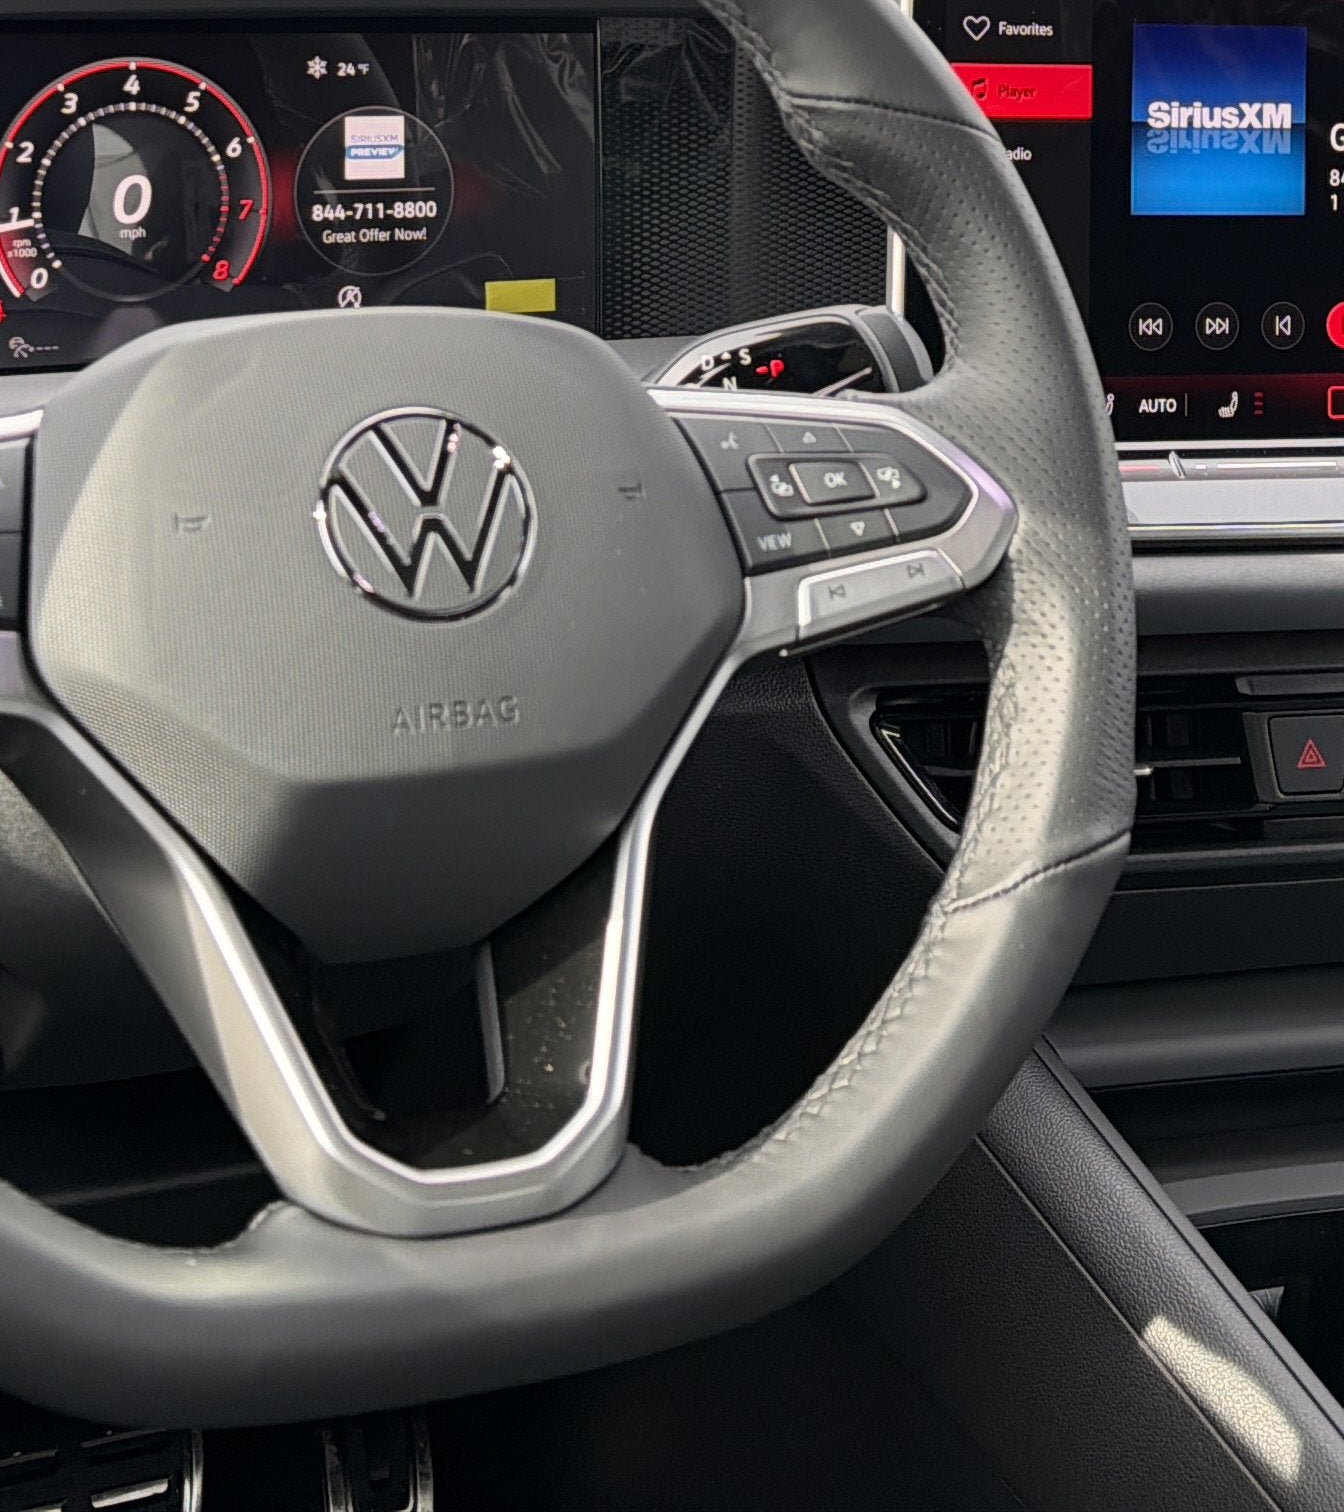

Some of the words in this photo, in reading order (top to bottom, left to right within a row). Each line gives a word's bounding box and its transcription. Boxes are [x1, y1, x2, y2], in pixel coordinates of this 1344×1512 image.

[998, 20, 1054, 38] Favorites
[336, 62, 356, 77] 24
[122, 74, 141, 95] 4
[997, 84, 1037, 101] Player
[60, 92, 79, 115] 3
[183, 92, 202, 113] 5
[1147, 100, 1292, 130] SiriusXM
[225, 136, 243, 158] 6
[351, 134, 399, 144] SIRIUSXM
[16, 140, 36, 165] 2
[350, 146, 399, 157] PREVIEW
[1006, 146, 1033, 162] adio
[112, 174, 152, 225] 0
[1330, 194, 1339, 212] 1
[7, 206, 21, 224] 1
[238, 199, 254, 220] 7
[312, 200, 437, 222] 844-711-8800
[119, 227, 147, 240] mph
[322, 229, 358, 244] Great
[359, 229, 392, 244] Offer
[394, 227, 427, 242] Now!
[12, 239, 32, 250] rpm
[30, 267, 49, 290] 0
[212, 259, 230, 281] 8
[701, 355, 716, 372] D
[739, 349, 752, 365] S
[770, 360, 785, 378] P
[722, 376, 739, 391] N
[1138, 397, 1178, 415] AUTO
[823, 471, 848, 488] OK
[391, 695, 521, 738] AIRBAG
